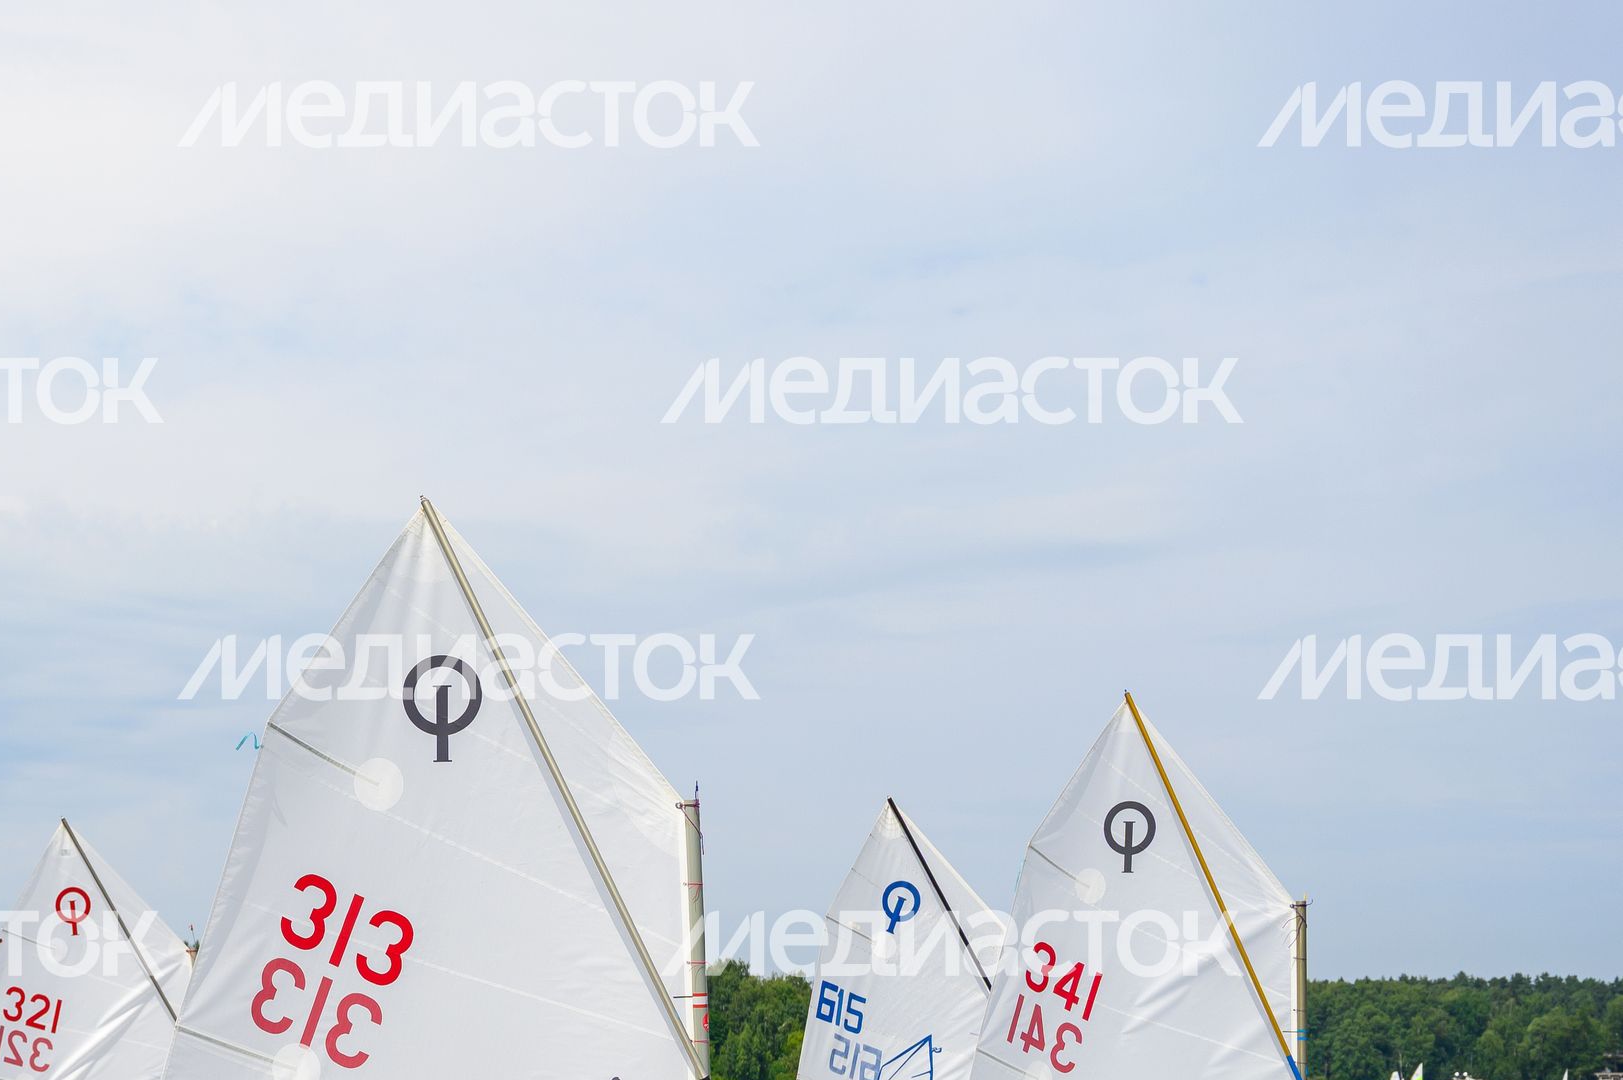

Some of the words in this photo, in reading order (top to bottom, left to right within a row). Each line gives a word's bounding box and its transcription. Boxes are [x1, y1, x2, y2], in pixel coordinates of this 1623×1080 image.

[280, 873, 414, 986] 313
[2, 986, 63, 1034] 321
[815, 980, 867, 1035] 615
[1026, 941, 1104, 1022] 341
